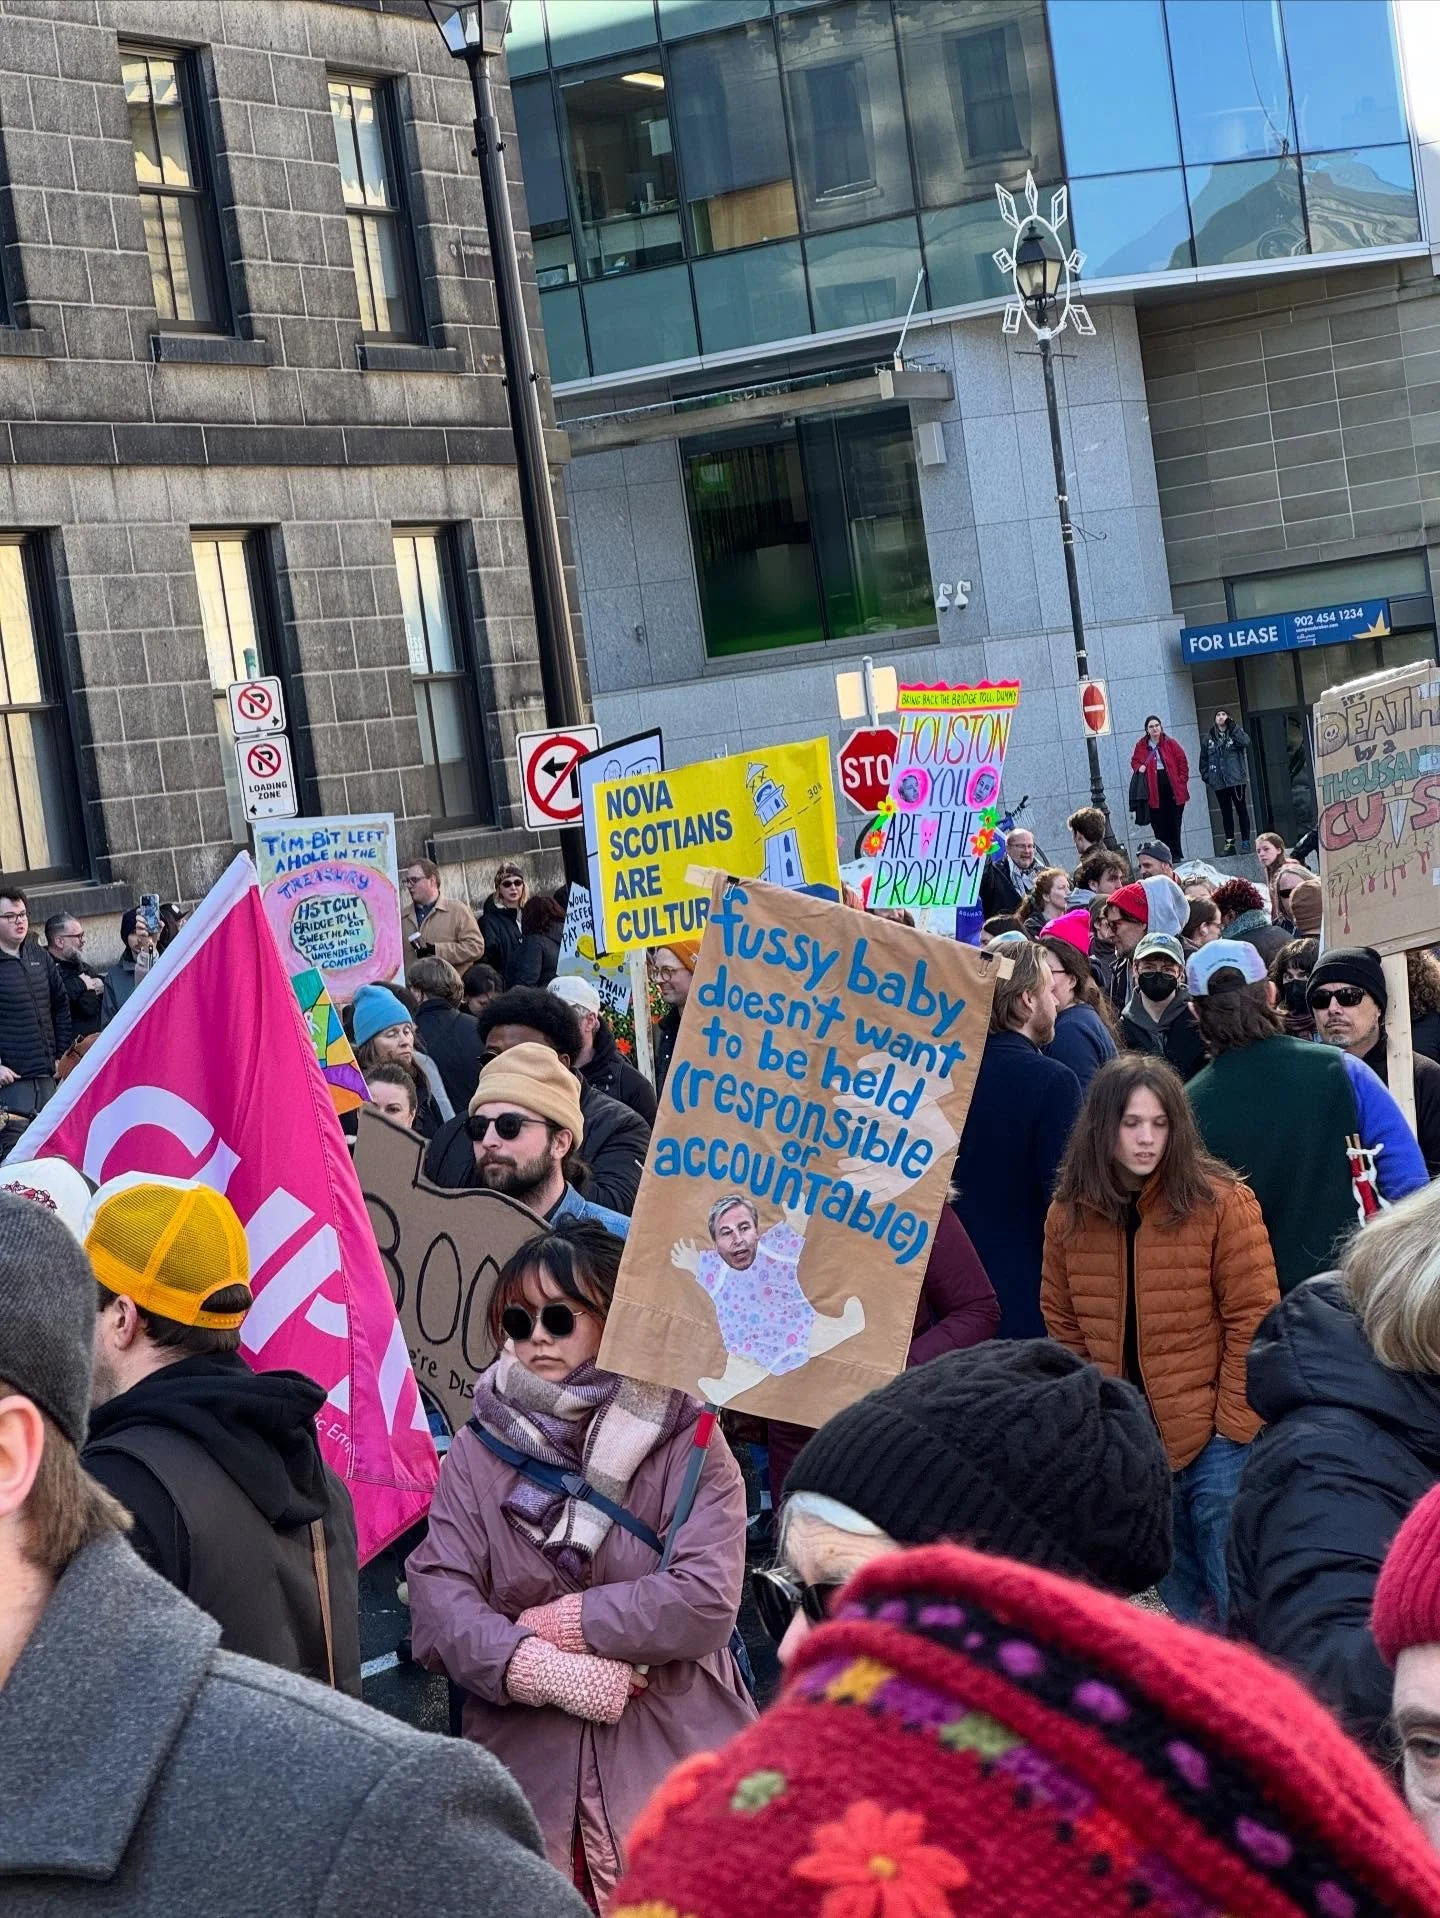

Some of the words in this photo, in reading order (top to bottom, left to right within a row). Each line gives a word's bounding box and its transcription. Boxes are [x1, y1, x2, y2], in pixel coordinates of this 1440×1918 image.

[1294, 614, 1314, 627] 902
[1317, 611, 1336, 623] 454
[1339, 607, 1363, 620] 1234
[1189, 634, 1224, 653] FOR
[1229, 626, 1278, 648] LEASE
[902, 693, 921, 705] BRING
[923, 693, 939, 705] BACK
[940, 693, 950, 705] THE
[951, 692, 977, 706] BRIDGE
[997, 689, 1016, 703] DUMMY
[1318, 682, 1440, 758] DEATH
[896, 713, 1010, 765] HOUSTON
[1355, 744, 1378, 762] by
[1383, 740, 1396, 754] a
[844, 754, 892, 789] STO
[249, 781, 288, 793] LOADING
[258, 790, 281, 800] ZONE
[605, 779, 673, 822] NOVA
[927, 768, 970, 808] YOU
[348, 830, 385, 844] LEFT
[609, 809, 733, 862] SCOTIANS
[882, 812, 922, 859] ARE
[930, 811, 982, 859] THE
[275, 859, 285, 874] A
[287, 850, 329, 872] HOLE
[334, 848, 347, 860] IN
[352, 848, 376, 859] THE
[278, 867, 369, 899] TREASURY
[613, 864, 663, 903] ARE
[873, 857, 980, 906] PROBLEM
[297, 900, 332, 921] HST
[332, 896, 360, 913] CUT
[568, 891, 589, 908] WOUL
[293, 917, 334, 935] BRIDGE
[335, 911, 359, 925] TOLL
[348, 919, 366, 928] CUT
[616, 896, 711, 943] CULTUR
[305, 940, 335, 954] DEALS
[562, 926, 577, 952] PAY
[710, 886, 840, 992] fussy
[598, 989, 625, 1013] OSE...
[599, 974, 627, 999] THAN
[847, 937, 967, 1039] baby
[697, 964, 847, 1040] doesn't
[855, 1017, 968, 1079] want
[701, 1014, 744, 1060] to
[757, 1029, 809, 1080] be
[821, 1046, 926, 1121] held
[780, 1139, 822, 1168] or
[409, 1348, 438, 1379] e're
[449, 1369, 475, 1399] DIS
